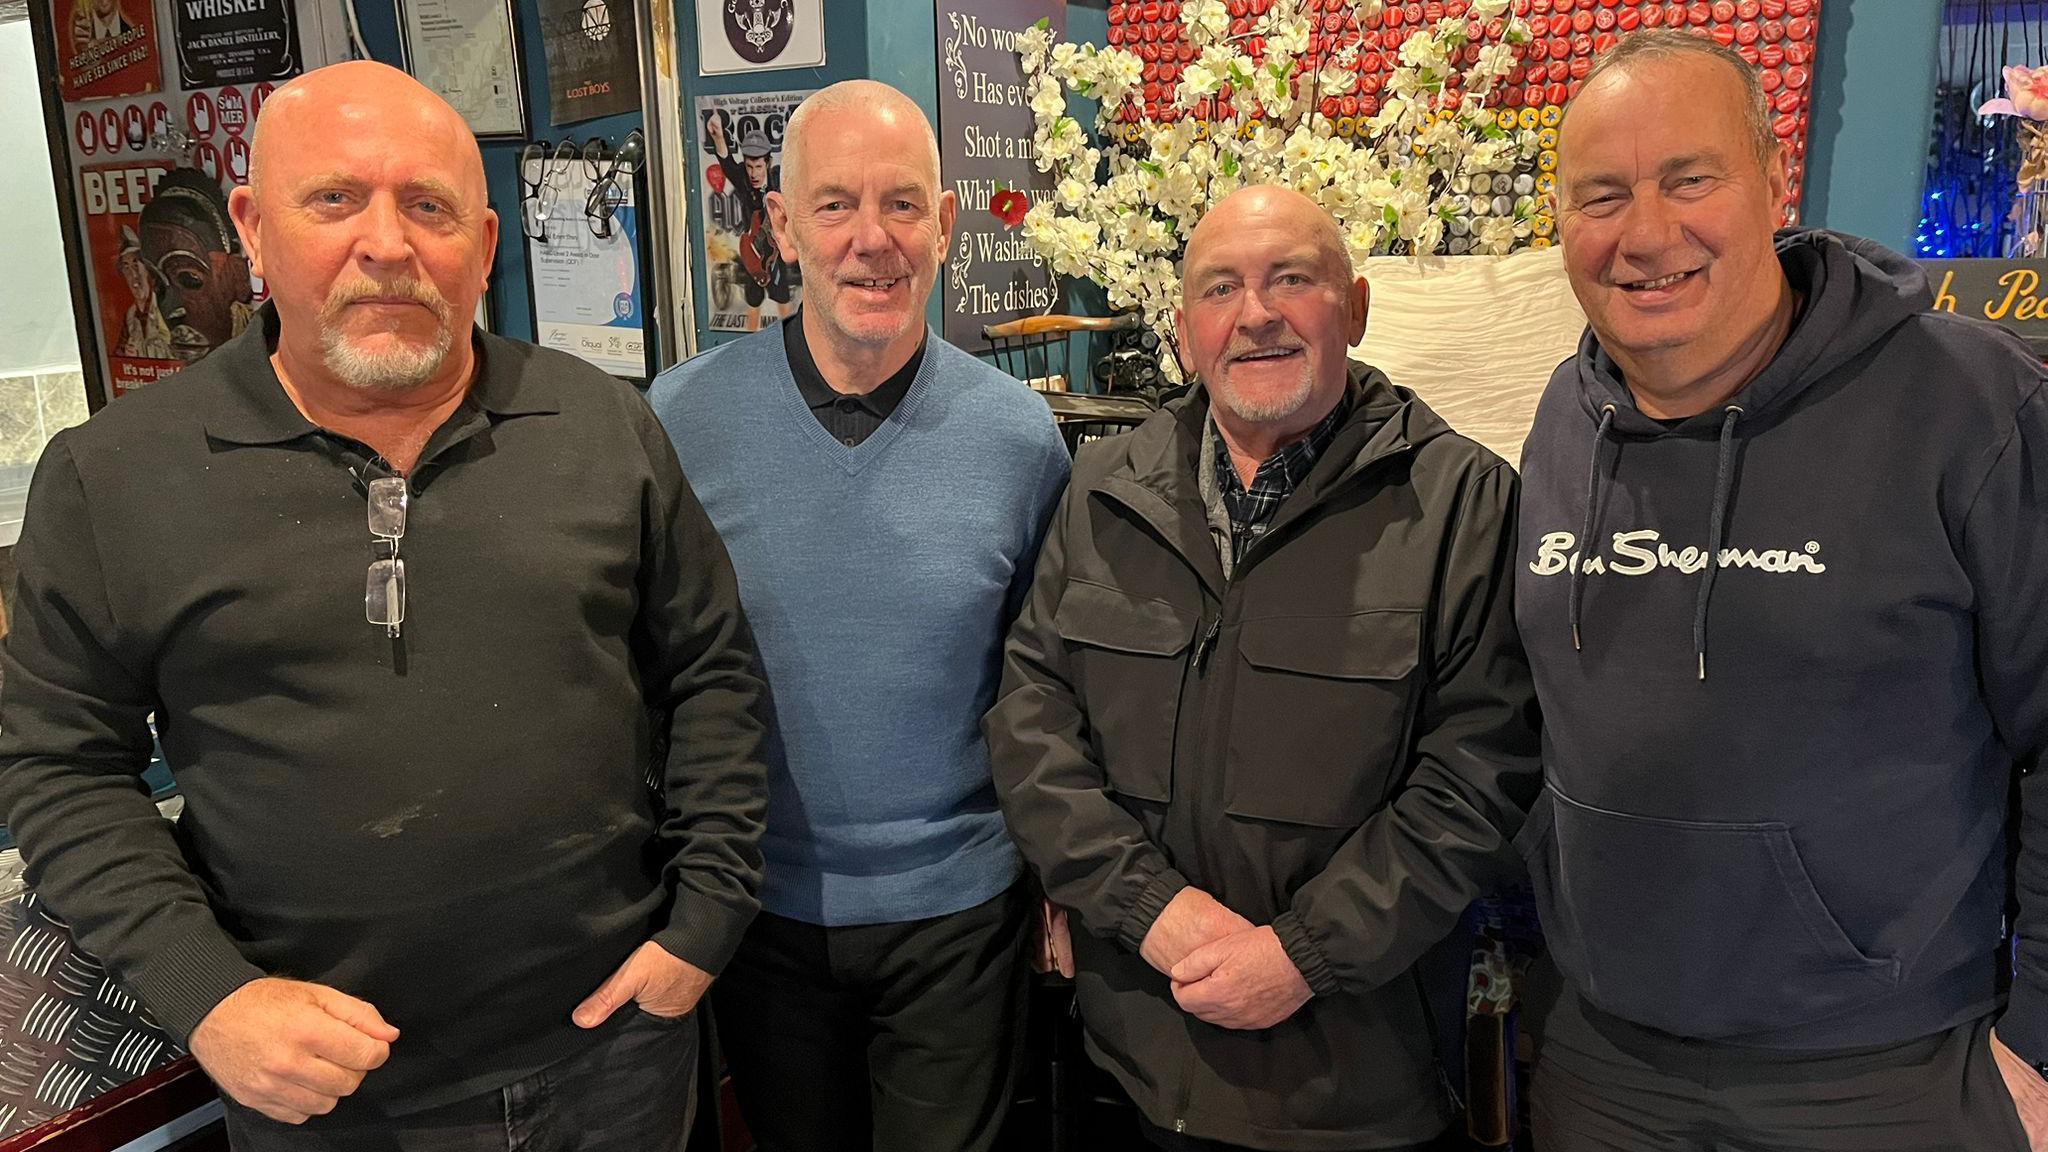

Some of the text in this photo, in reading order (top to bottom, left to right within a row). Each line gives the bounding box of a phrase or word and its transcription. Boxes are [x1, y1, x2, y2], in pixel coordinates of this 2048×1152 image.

[186, 0, 266, 20] WHISKEY
[962, 15, 987, 48] No
[566, 82, 610, 99] LOST BOYS
[781, 90, 803, 102] Edition
[972, 71, 1003, 106] Has
[964, 124, 1001, 159] Shot
[1005, 137, 1014, 159] a
[956, 178, 998, 211] Whil
[969, 279, 1049, 315] The dishes
[1932, 269, 1958, 314] h
[726, 313, 748, 329] LAST
[138, 366, 155, 377] not
